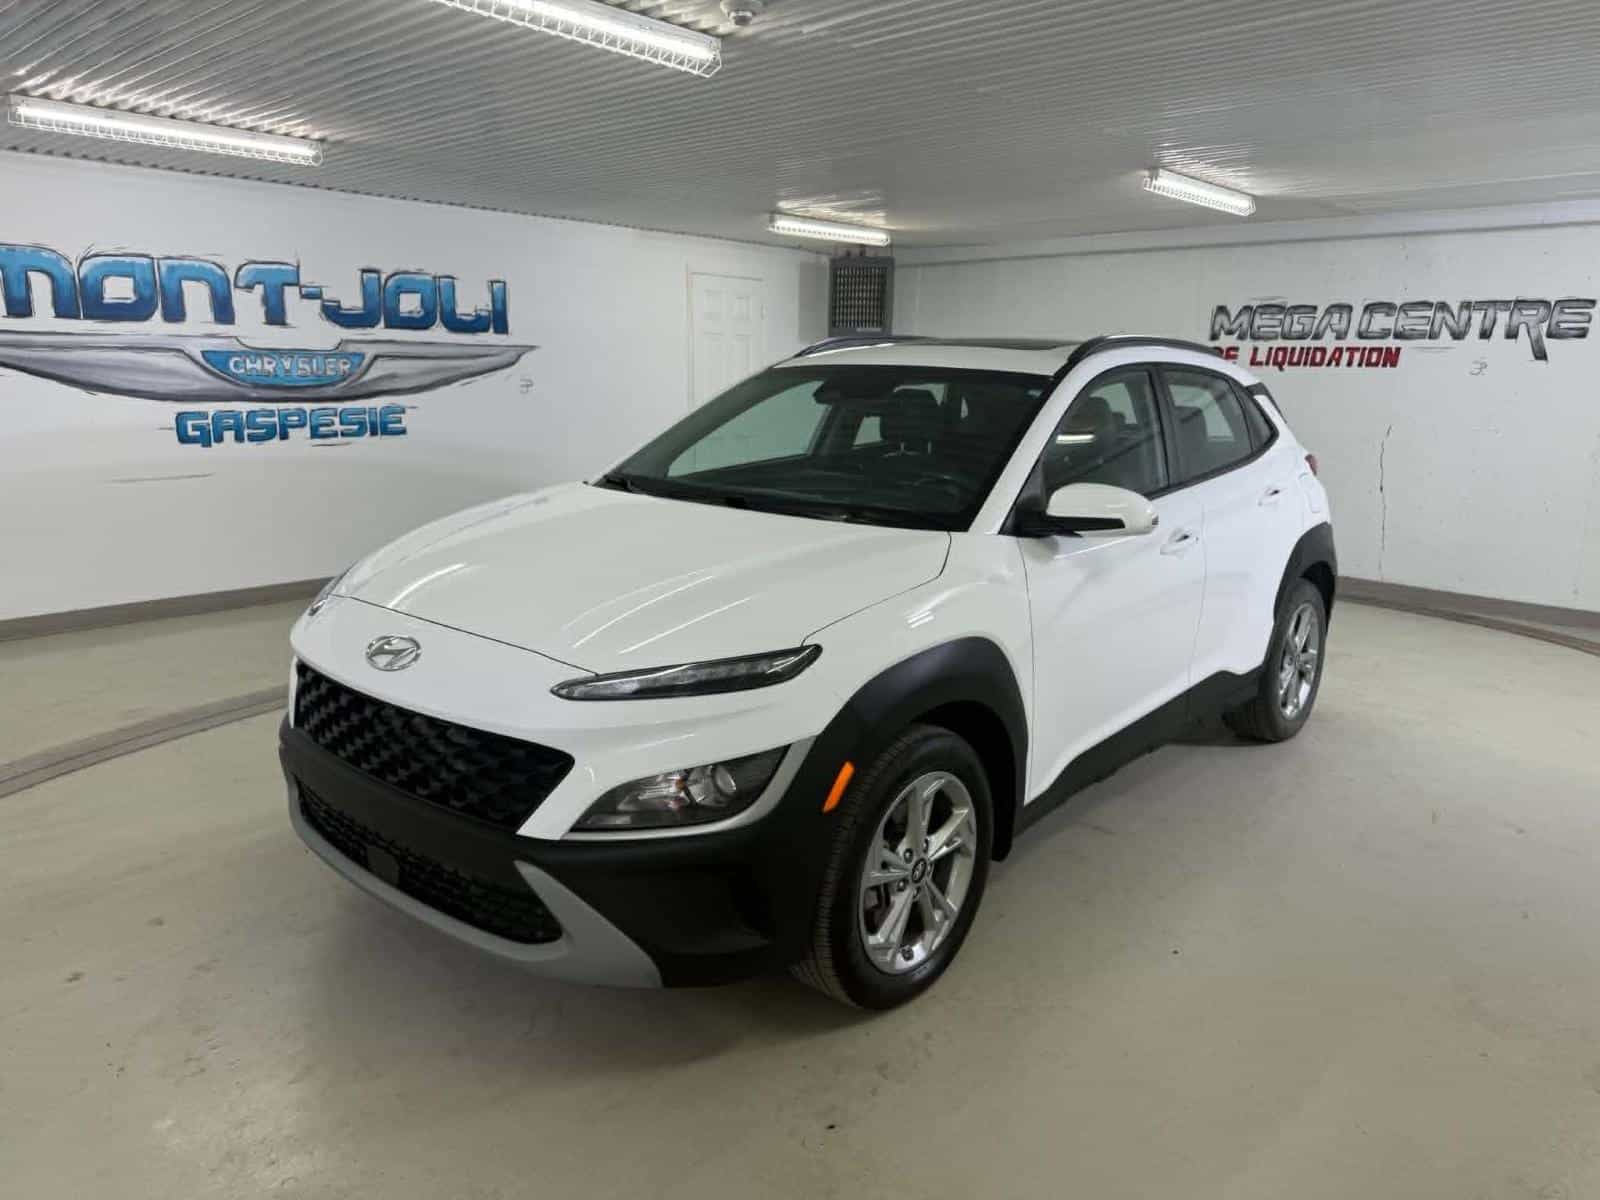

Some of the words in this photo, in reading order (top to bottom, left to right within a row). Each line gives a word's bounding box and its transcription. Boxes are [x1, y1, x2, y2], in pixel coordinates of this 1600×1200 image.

[1210, 303, 1354, 341] MEGA
[1357, 298, 1597, 361] CENTRE
[229, 356, 350, 376] CHRYSLER
[1250, 346, 1402, 371] LIQUIDATION
[175, 405, 407, 448] GASPESIE
